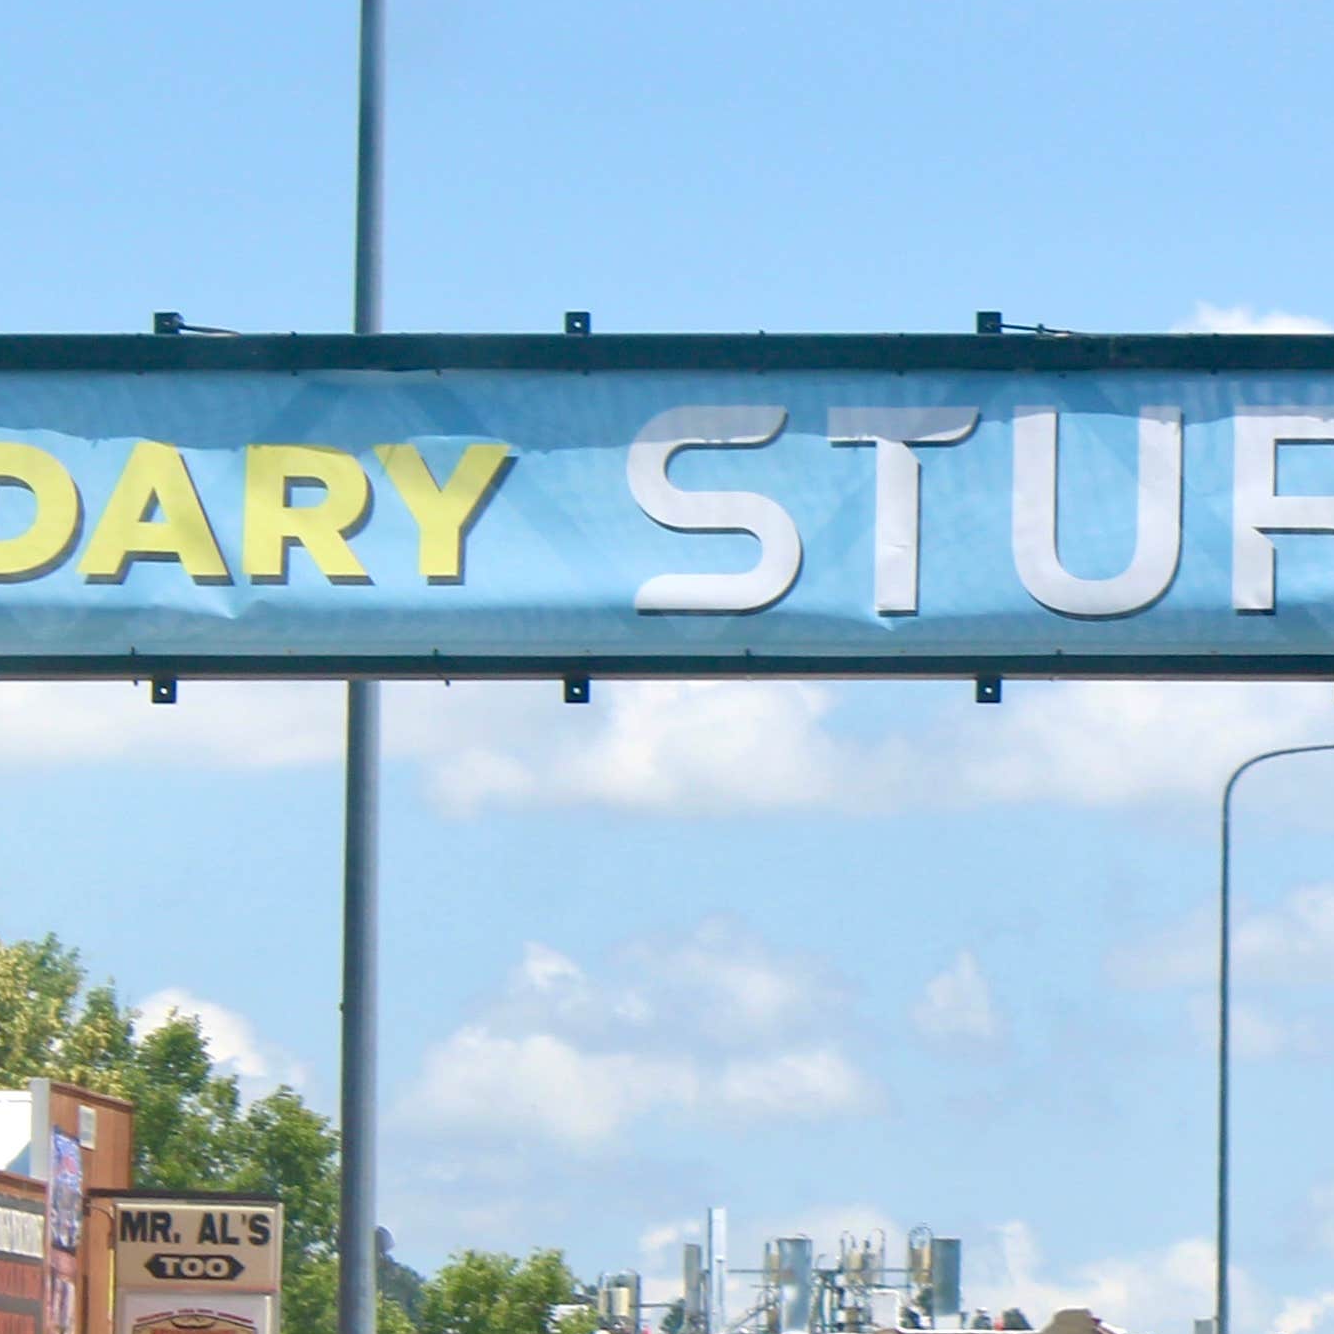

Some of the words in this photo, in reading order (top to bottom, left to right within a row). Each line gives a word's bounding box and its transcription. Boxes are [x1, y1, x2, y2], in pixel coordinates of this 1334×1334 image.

[120, 1210, 181, 1244] MR.
[197, 1212, 271, 1246] AL'S
[159, 1256, 230, 1278] TOO
